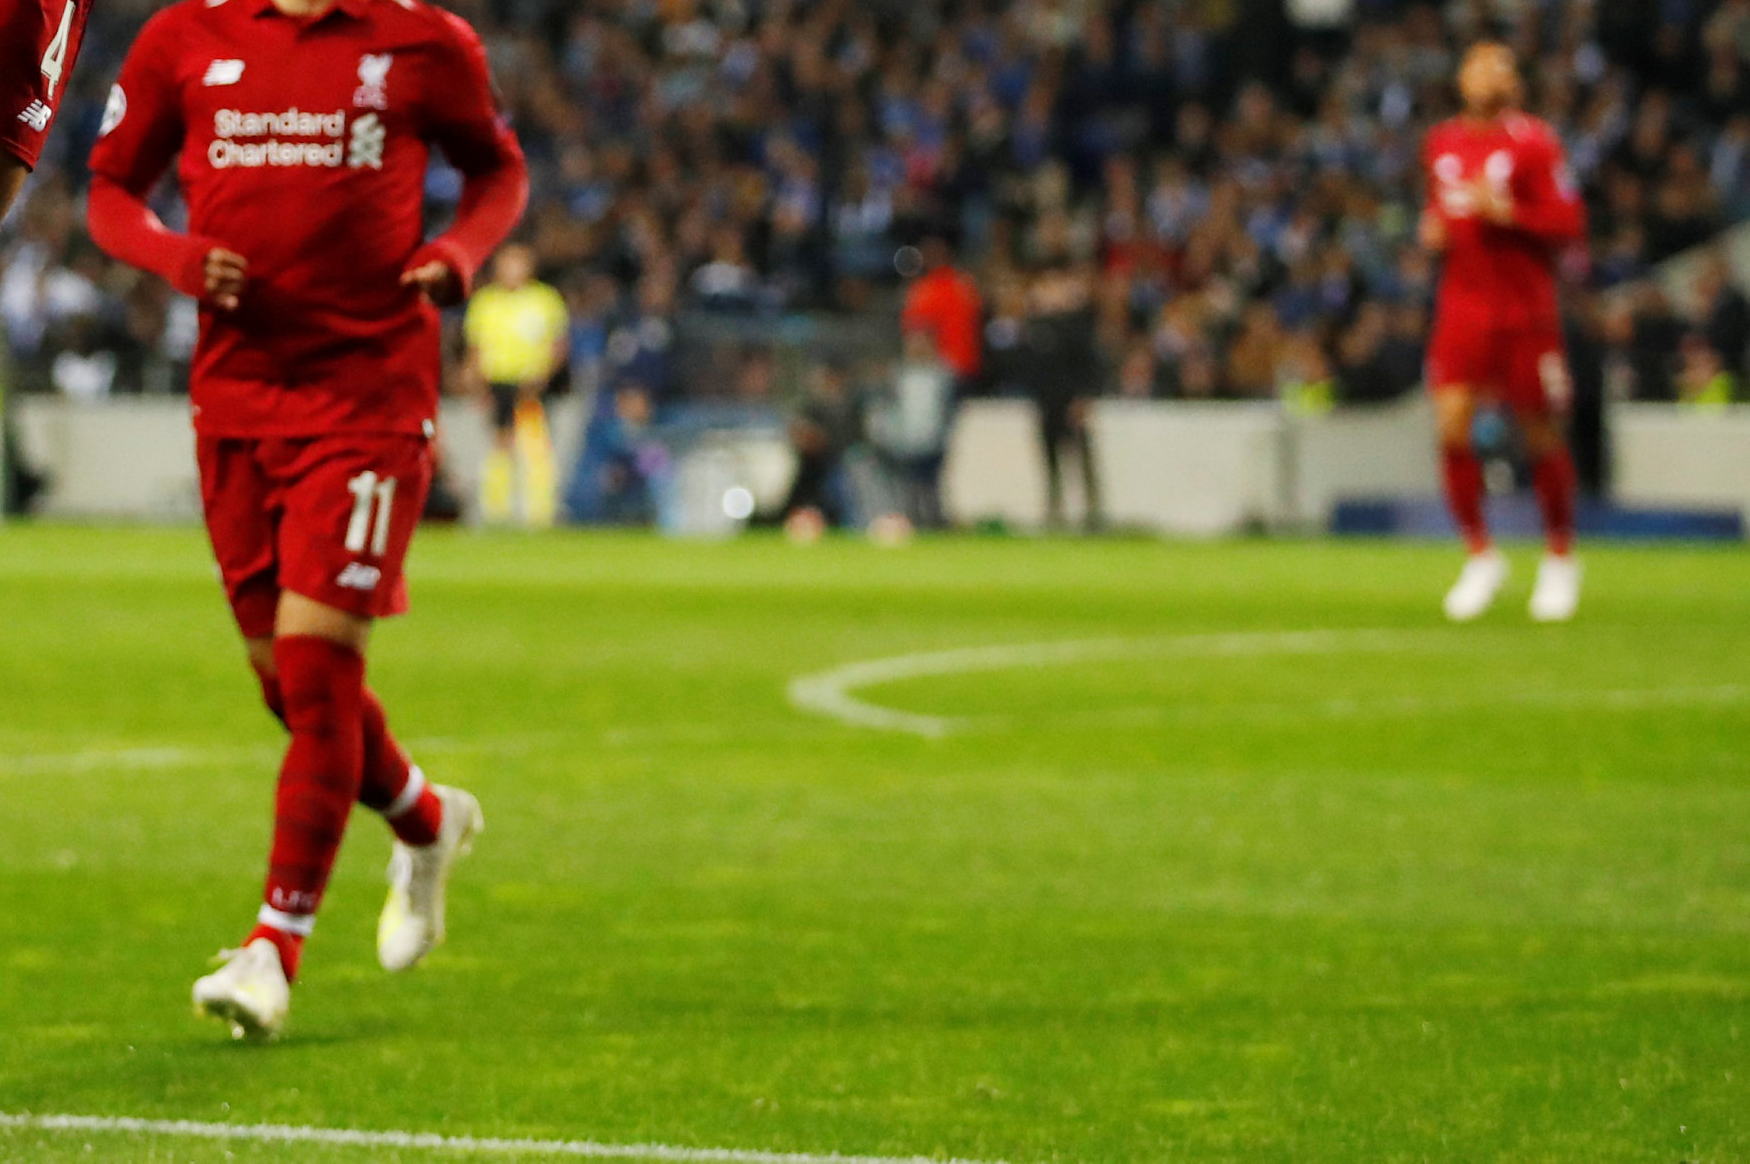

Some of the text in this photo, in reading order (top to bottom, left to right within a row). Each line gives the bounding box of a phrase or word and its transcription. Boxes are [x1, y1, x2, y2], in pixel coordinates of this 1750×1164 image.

[41, 0, 76, 100] 4
[214, 107, 345, 138] Standard
[208, 138, 343, 169] Chartered
[345, 470, 398, 557] 11
